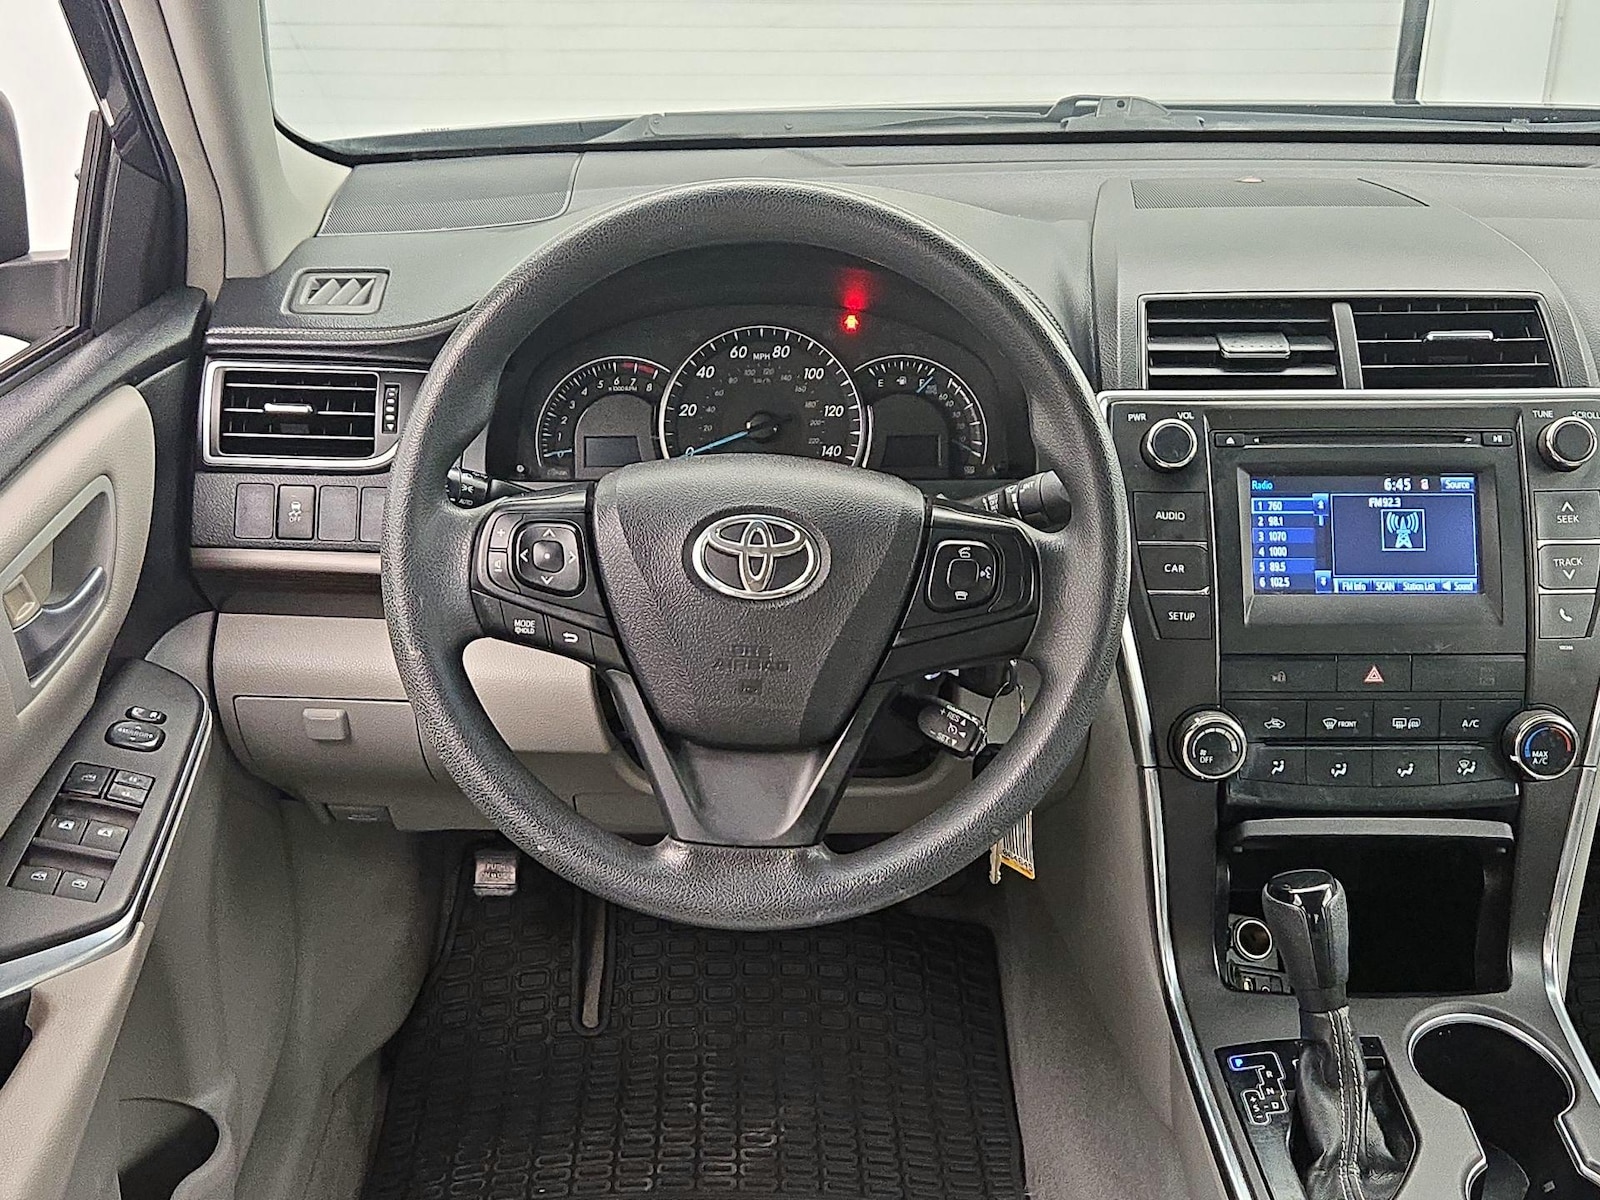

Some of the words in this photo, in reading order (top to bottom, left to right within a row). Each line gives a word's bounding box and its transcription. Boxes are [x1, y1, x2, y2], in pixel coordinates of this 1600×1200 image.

[730, 345, 748, 359] 60
[772, 345, 790, 359] 80
[696, 365, 715, 379] 40
[803, 367, 824, 380] 100
[597, 380, 604, 389] 5
[614, 377, 620, 386] 6
[630, 377, 637, 386] 7
[878, 379, 884, 388] E
[581, 387, 588, 396] 4
[646, 383, 652, 392] 8
[569, 400, 576, 409] 3
[679, 404, 698, 417] 20
[824, 405, 844, 417] 120
[1532, 409, 1554, 418] TUNE
[1128, 413, 1147, 422] PWR
[1177, 412, 1195, 420] VOL
[1571, 411, 1600, 420] SCROLL
[561, 416, 568, 425] 2
[821, 445, 842, 457] 140
[1251, 480, 1273, 490] Radio
[1384, 477, 1411, 491] 6:45
[1445, 480, 1470, 489] Source
[1258, 501, 1263, 511] 1
[1267, 501, 1283, 511] 760
[1155, 511, 1186, 521] AUDIO
[1556, 514, 1579, 524] SEEK
[1257, 516, 1264, 526] 2
[1258, 531, 1264, 541] 3
[1269, 531, 1287, 541] 1070
[1258, 547, 1265, 557] 4
[1269, 547, 1288, 557] 1000
[1553, 557, 1583, 567] TRACK
[1164, 563, 1185, 573] CAR
[1259, 562, 1265, 572] 5
[1259, 577, 1266, 588] 6
[1376, 582, 1395, 591] SCAN
[1454, 582, 1473, 591] Sound
[1168, 611, 1196, 621] SETUP
[514, 619, 536, 628] MODE
[1337, 720, 1358, 728] FRONT
[1461, 719, 1480, 727] A/C
[1531, 750, 1548, 758] MAX
[1200, 756, 1213, 764] OFF
[1532, 757, 1548, 765] A/C
[1266, 1070, 1273, 1078] R
[1266, 1087, 1275, 1095] N
[1252, 1104, 1260, 1112] S
